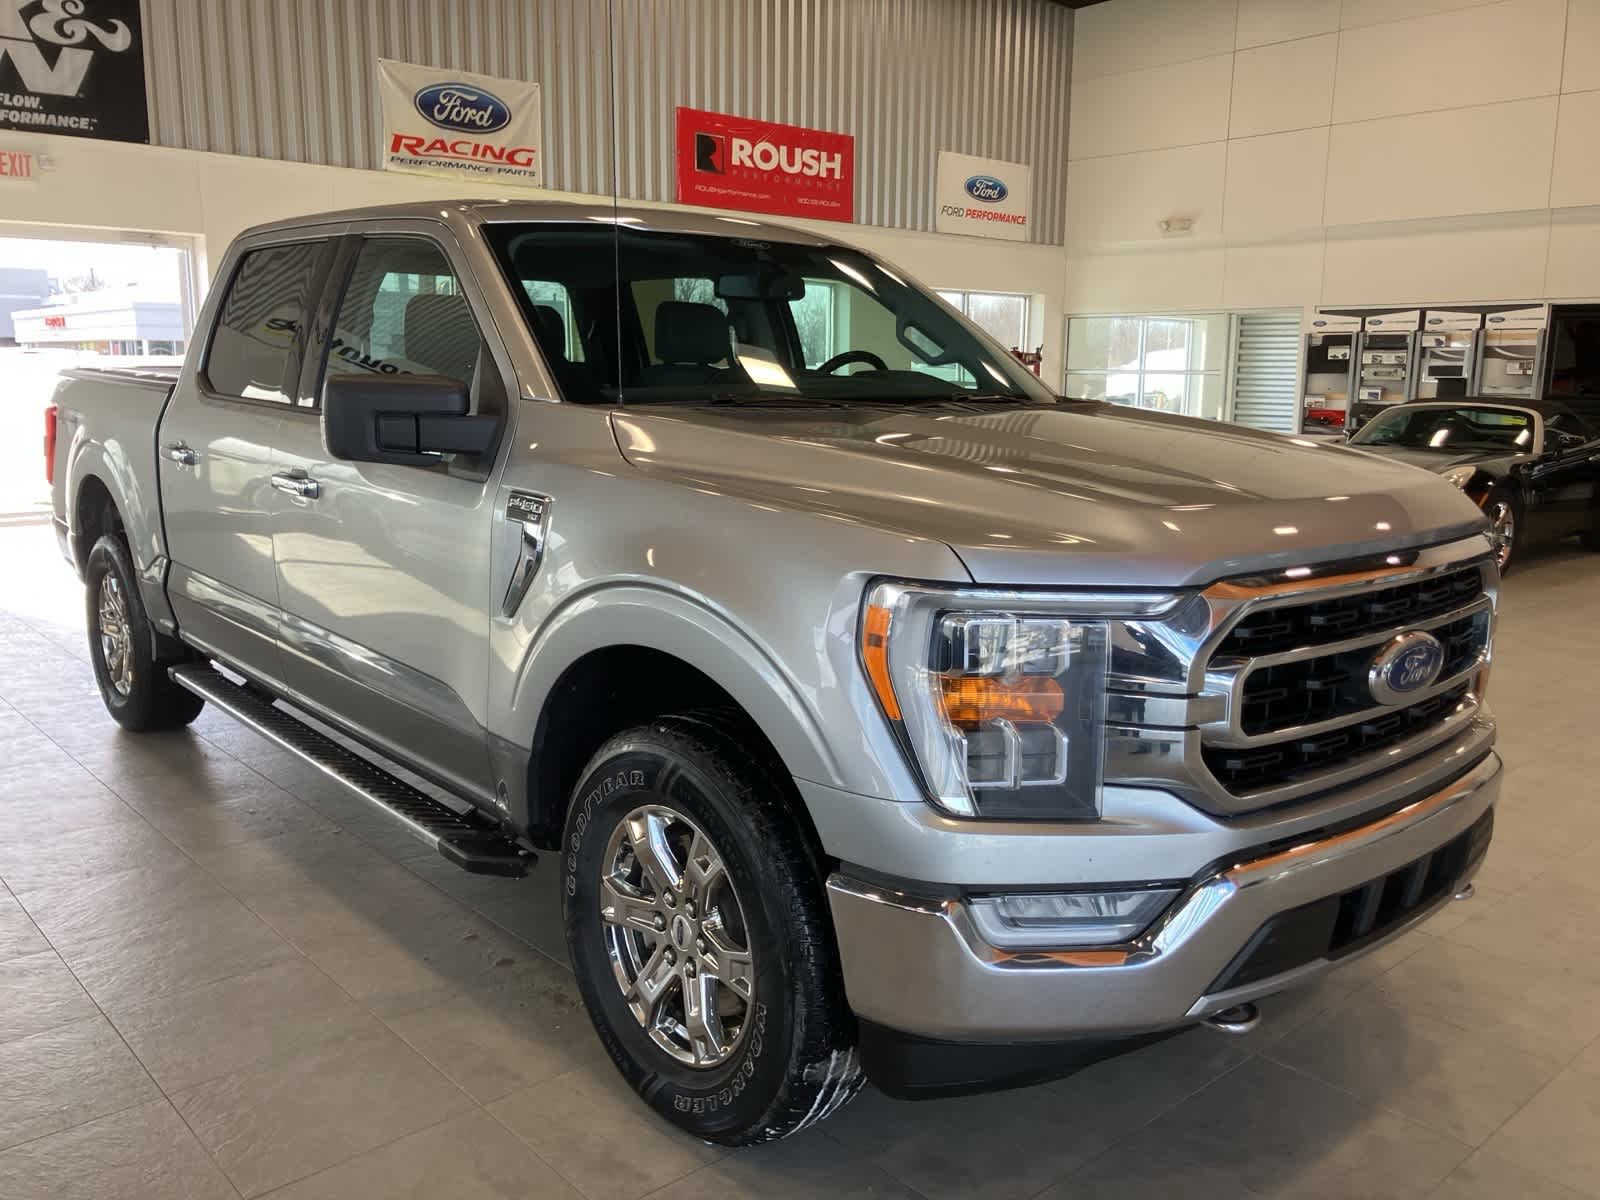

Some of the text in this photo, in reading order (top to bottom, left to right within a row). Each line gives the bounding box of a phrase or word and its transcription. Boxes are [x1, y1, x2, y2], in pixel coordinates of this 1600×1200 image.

[433, 89, 493, 127] Ford
[0, 151, 31, 177] EXIT
[390, 132, 536, 168] RACING
[731, 137, 842, 180] ROUSH
[390, 155, 536, 177] PERFORMANCE PARTS
[972, 179, 1000, 199] Ford
[940, 205, 1027, 225] FORD PERFORMANCE
[1400, 655, 1434, 686] Ford
[566, 770, 646, 897] GOODYEAR
